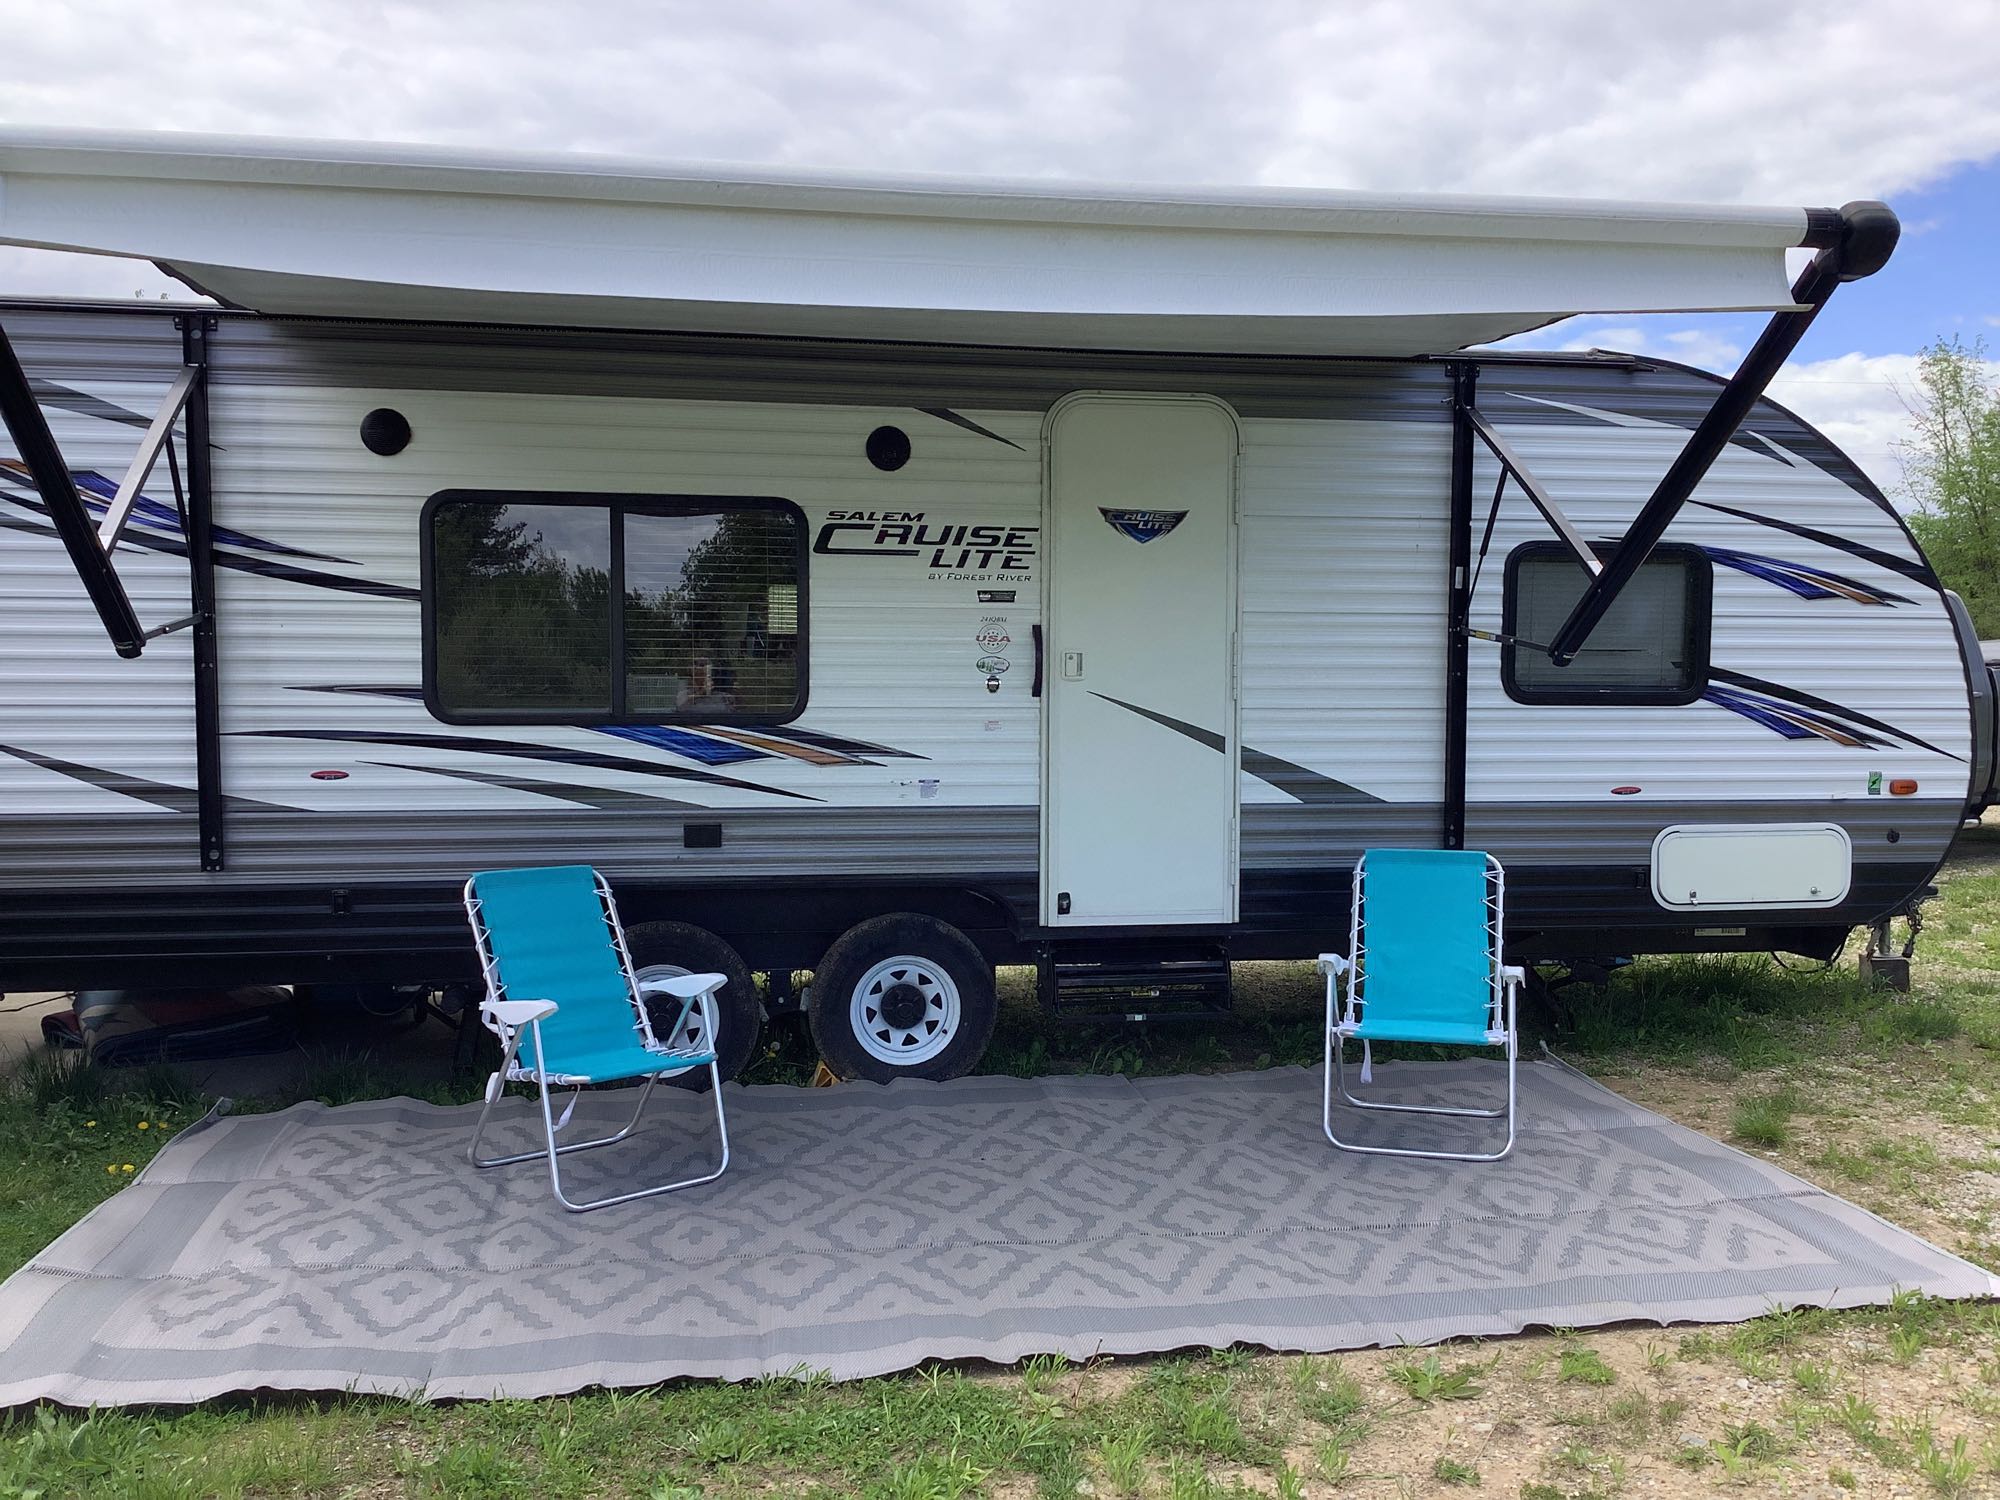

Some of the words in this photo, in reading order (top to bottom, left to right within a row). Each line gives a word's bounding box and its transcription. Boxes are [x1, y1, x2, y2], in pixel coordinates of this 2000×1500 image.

[826, 510, 925, 522] SALEM
[1105, 511, 1177, 524] CRUISE
[1138, 521, 1172, 530] LITE
[813, 523, 1040, 557] CRUISE
[929, 548, 1036, 570] LITE
[947, 572, 993, 581] FOREST
[996, 573, 1032, 582] RIVER
[976, 634, 1011, 643] USA
